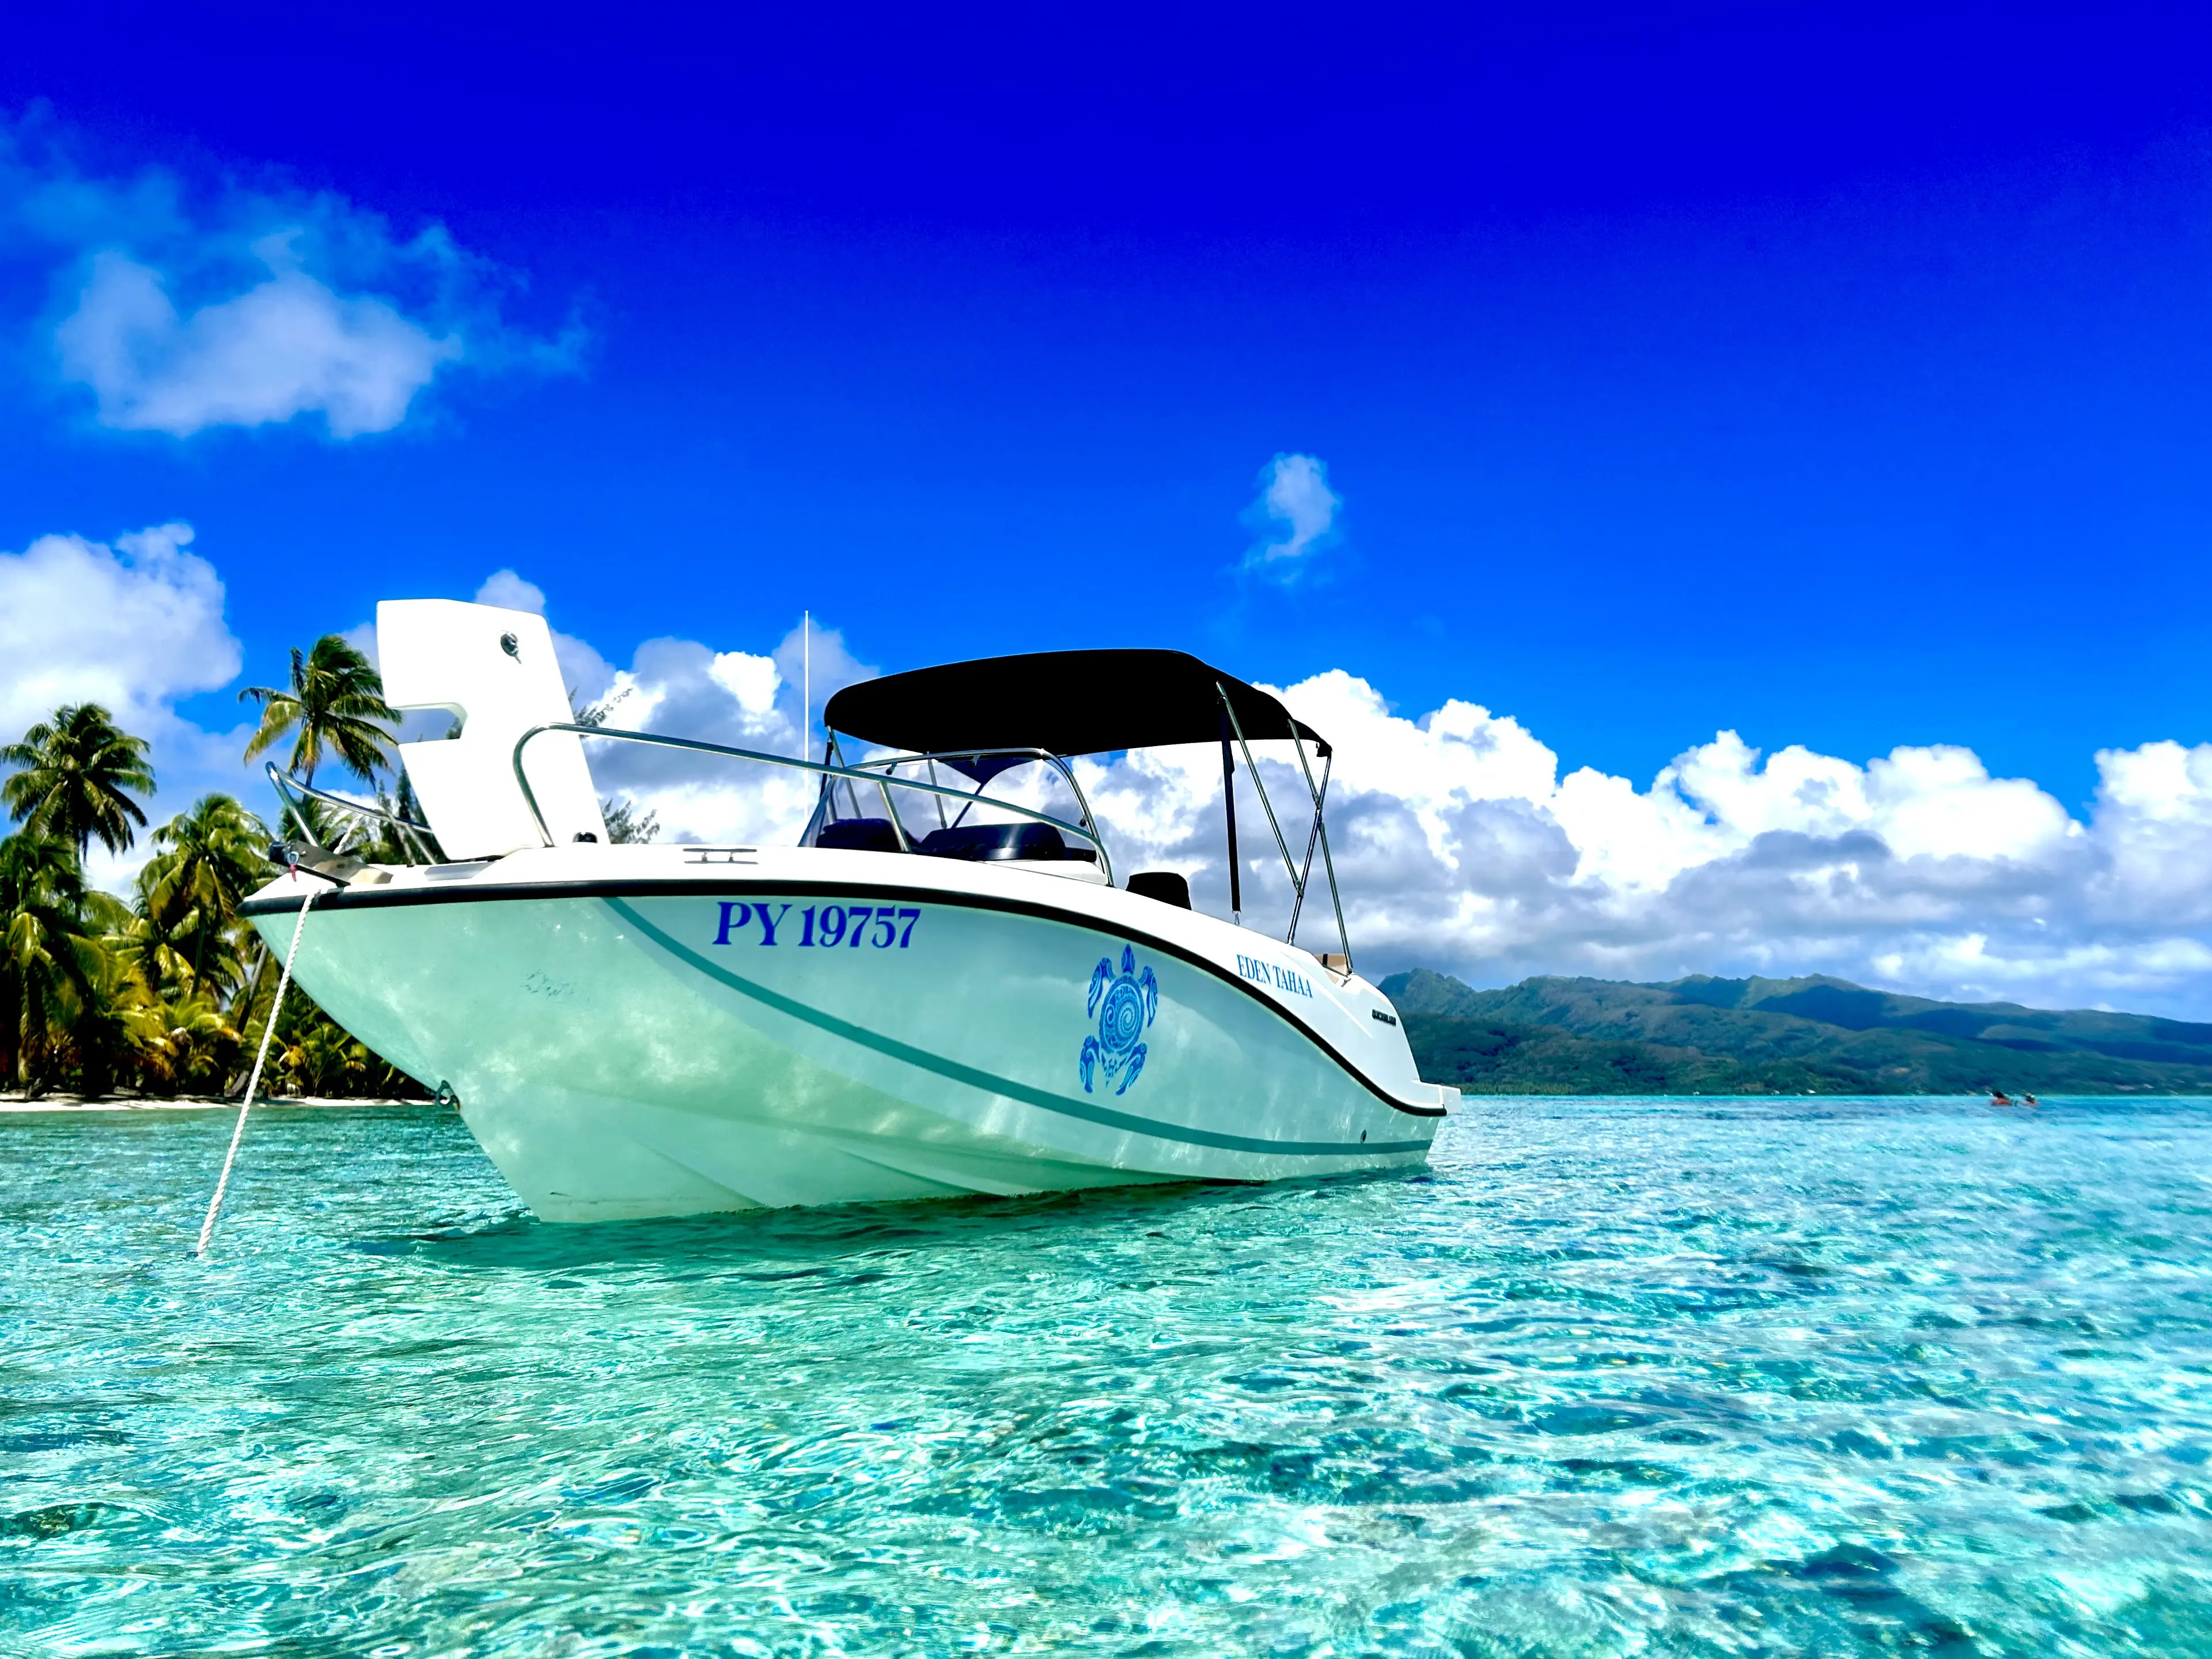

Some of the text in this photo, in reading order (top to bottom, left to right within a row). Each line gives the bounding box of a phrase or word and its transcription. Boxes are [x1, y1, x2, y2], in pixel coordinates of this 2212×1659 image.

[712, 902, 922, 948] PY 19757
[1236, 954, 1313, 998] EDEN TAHAA
